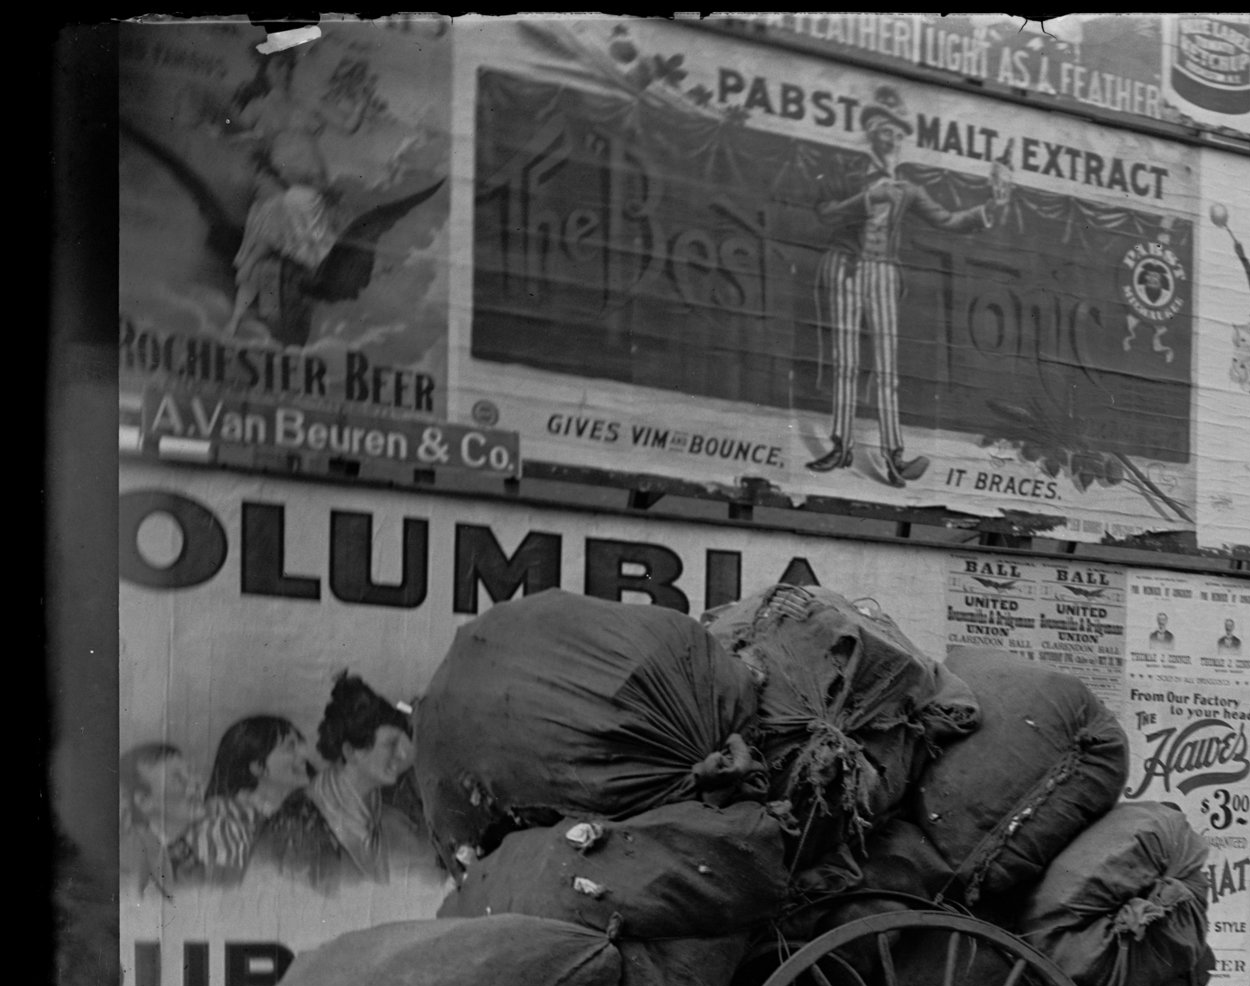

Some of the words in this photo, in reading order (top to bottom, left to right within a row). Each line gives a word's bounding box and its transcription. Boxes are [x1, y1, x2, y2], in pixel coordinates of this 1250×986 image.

[925, 26, 988, 79] LIGHT
[998, 46, 1032, 88] AS
[1060, 62, 1163, 120] FEATHER
[718, 67, 860, 132] PABST
[916, 113, 997, 162] MALT
[1021, 136, 1169, 199] EXTRACT
[120, 320, 328, 397] ROCHESTER
[344, 349, 436, 413] BEER
[274, 406, 408, 462] Beuren
[415, 425, 450, 465] &
[459, 430, 517, 473] Co.
[547, 412, 621, 443] GIVES
[630, 424, 670, 450] VIM
[688, 433, 786, 469] BOUNCE,
[945, 468, 967, 487] IT
[973, 471, 1062, 501] BRACES.
[965, 560, 1022, 578] BALL
[1056, 568, 1111, 586] BALL
[964, 595, 1019, 612] UNITED
[1056, 603, 1108, 619] UNITED
[966, 624, 1010, 637] UNION
[1058, 632, 1100, 644] UNION
[1130, 688, 1165, 702] From
[1166, 691, 1191, 704] Our
[1193, 693, 1240, 709] Factory
[1135, 711, 1158, 731] THE
[1170, 705, 1184, 716] to
[1187, 708, 1221, 720] your
[1214, 921, 1248, 934] STYLE
